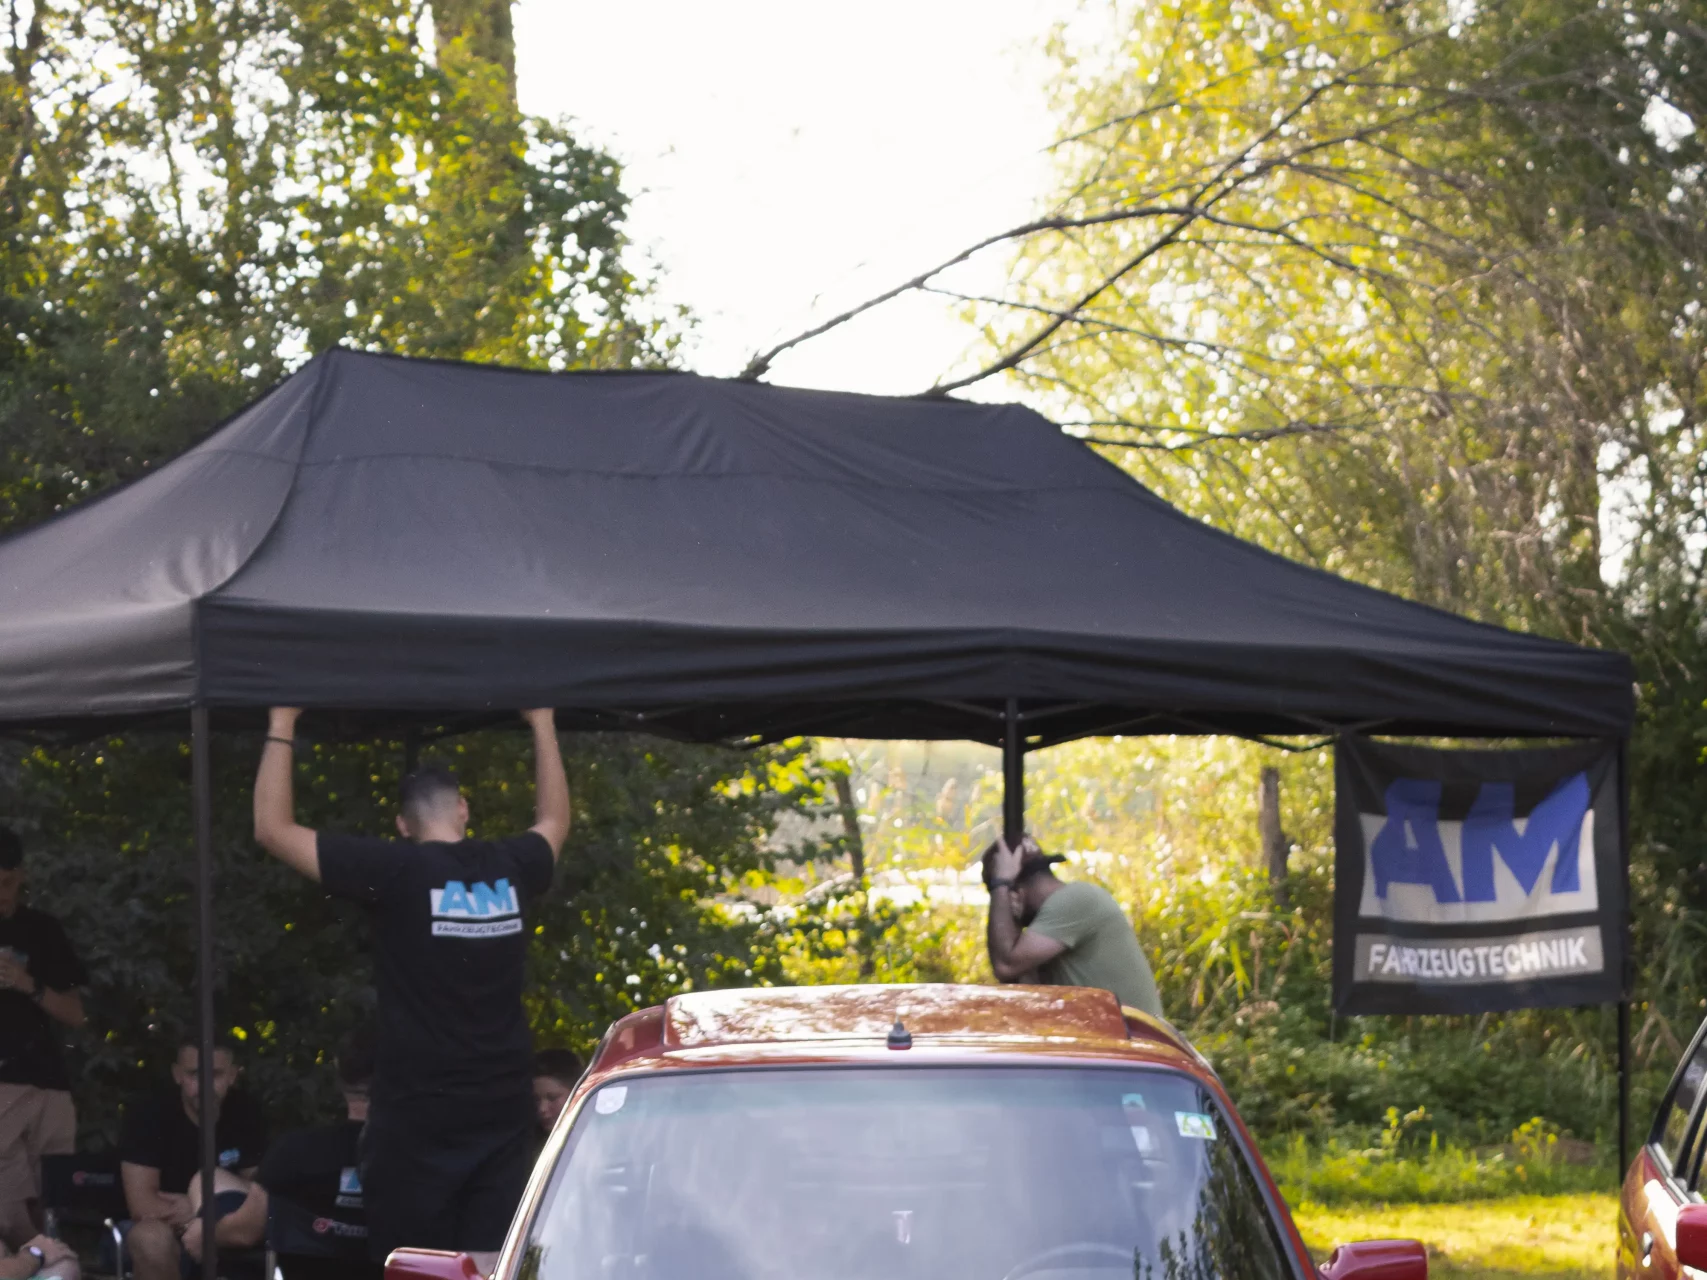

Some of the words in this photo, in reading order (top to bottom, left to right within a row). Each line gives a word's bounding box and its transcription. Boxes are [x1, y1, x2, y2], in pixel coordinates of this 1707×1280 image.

[1371, 771, 1591, 904] AM
[438, 877, 514, 915] AM
[1368, 936, 1588, 977] FAHRZEUGTECHNIK
